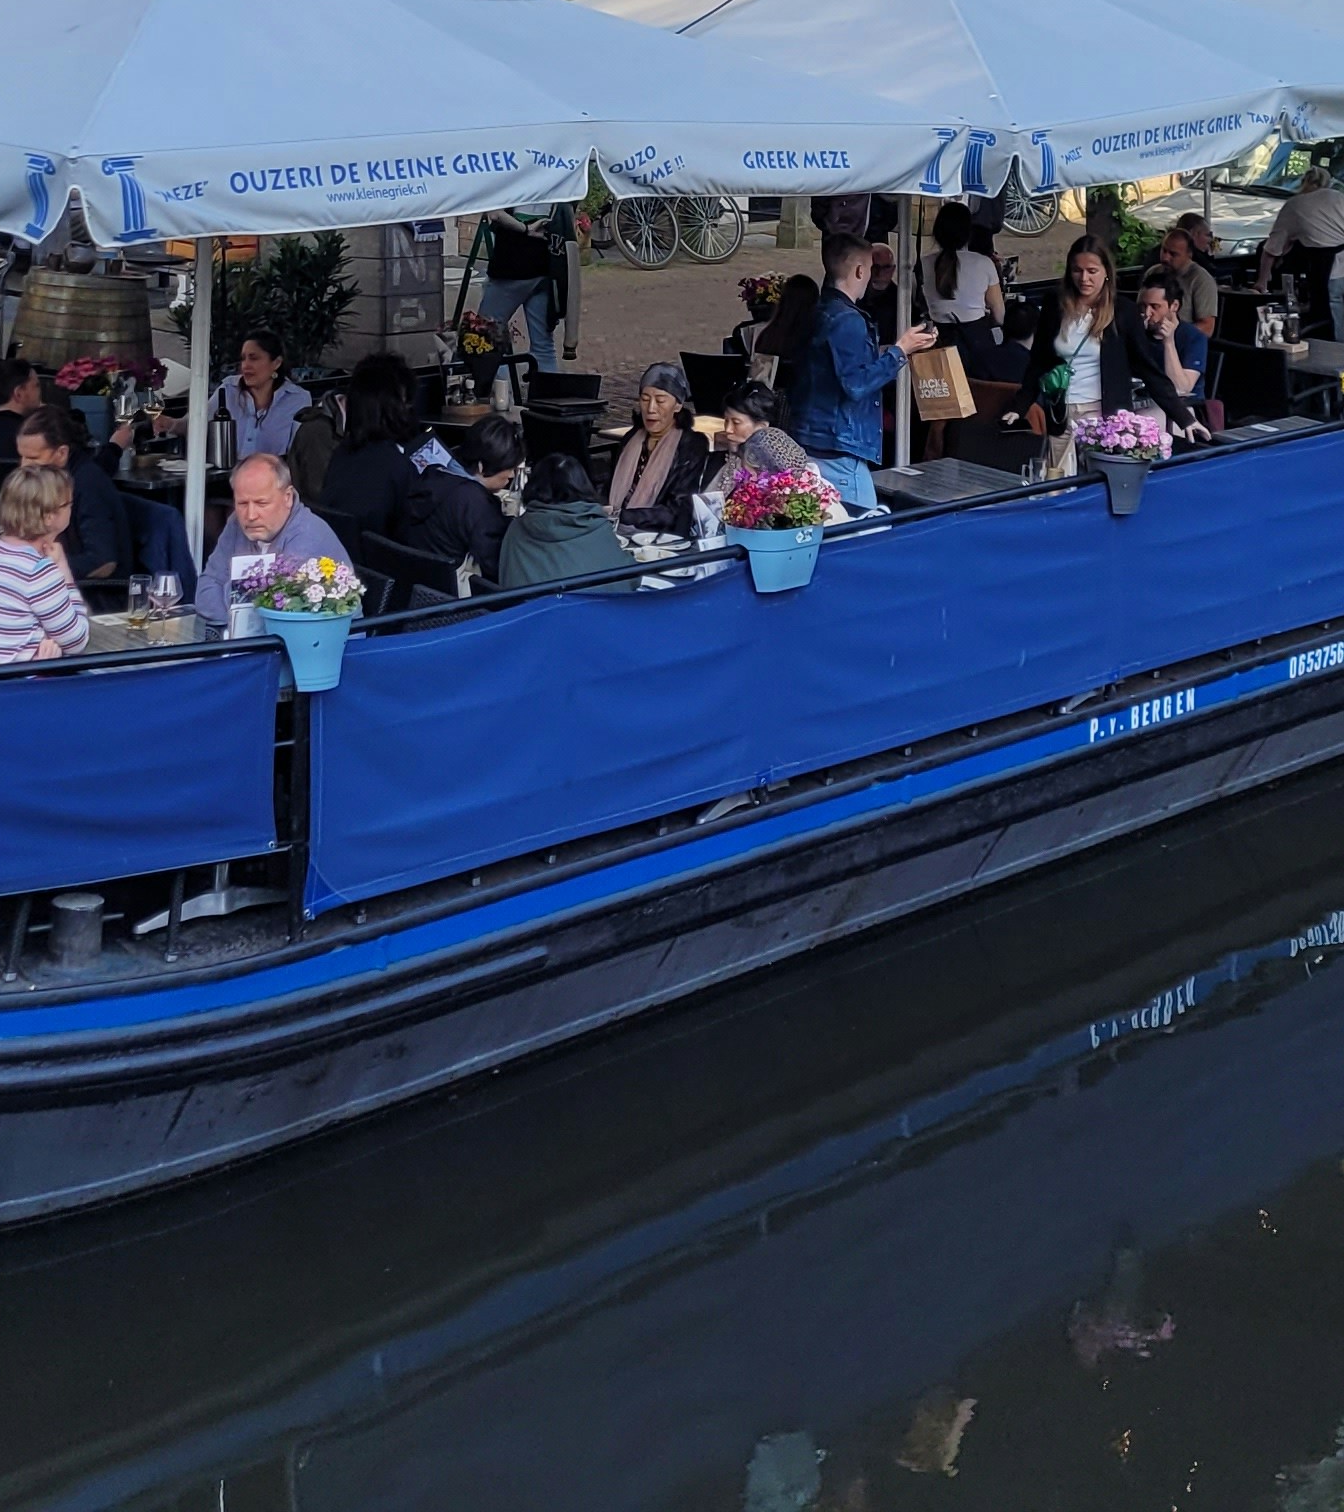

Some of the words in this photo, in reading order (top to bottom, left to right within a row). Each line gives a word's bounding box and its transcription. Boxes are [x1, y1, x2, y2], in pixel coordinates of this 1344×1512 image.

[1091, 129, 1141, 156] OUZERI
[1144, 126, 1160, 145] DE
[1163, 119, 1205, 144] KLEINE
[1207, 113, 1242, 135] GRIEK
[229, 165, 323, 195] OUZERI
[329, 162, 361, 186] DE
[366, 154, 448, 183] KLEINE
[452, 150, 520, 175] GRIEK
[608, 145, 657, 175] OUZO
[742, 149, 799, 170] GREEK
[803, 150, 851, 169] MEZE
[326, 182, 428, 203] www.kleinegriek.nl
[919, 387, 951, 399] JONES
[1130, 687, 1195, 730] BERGEN
